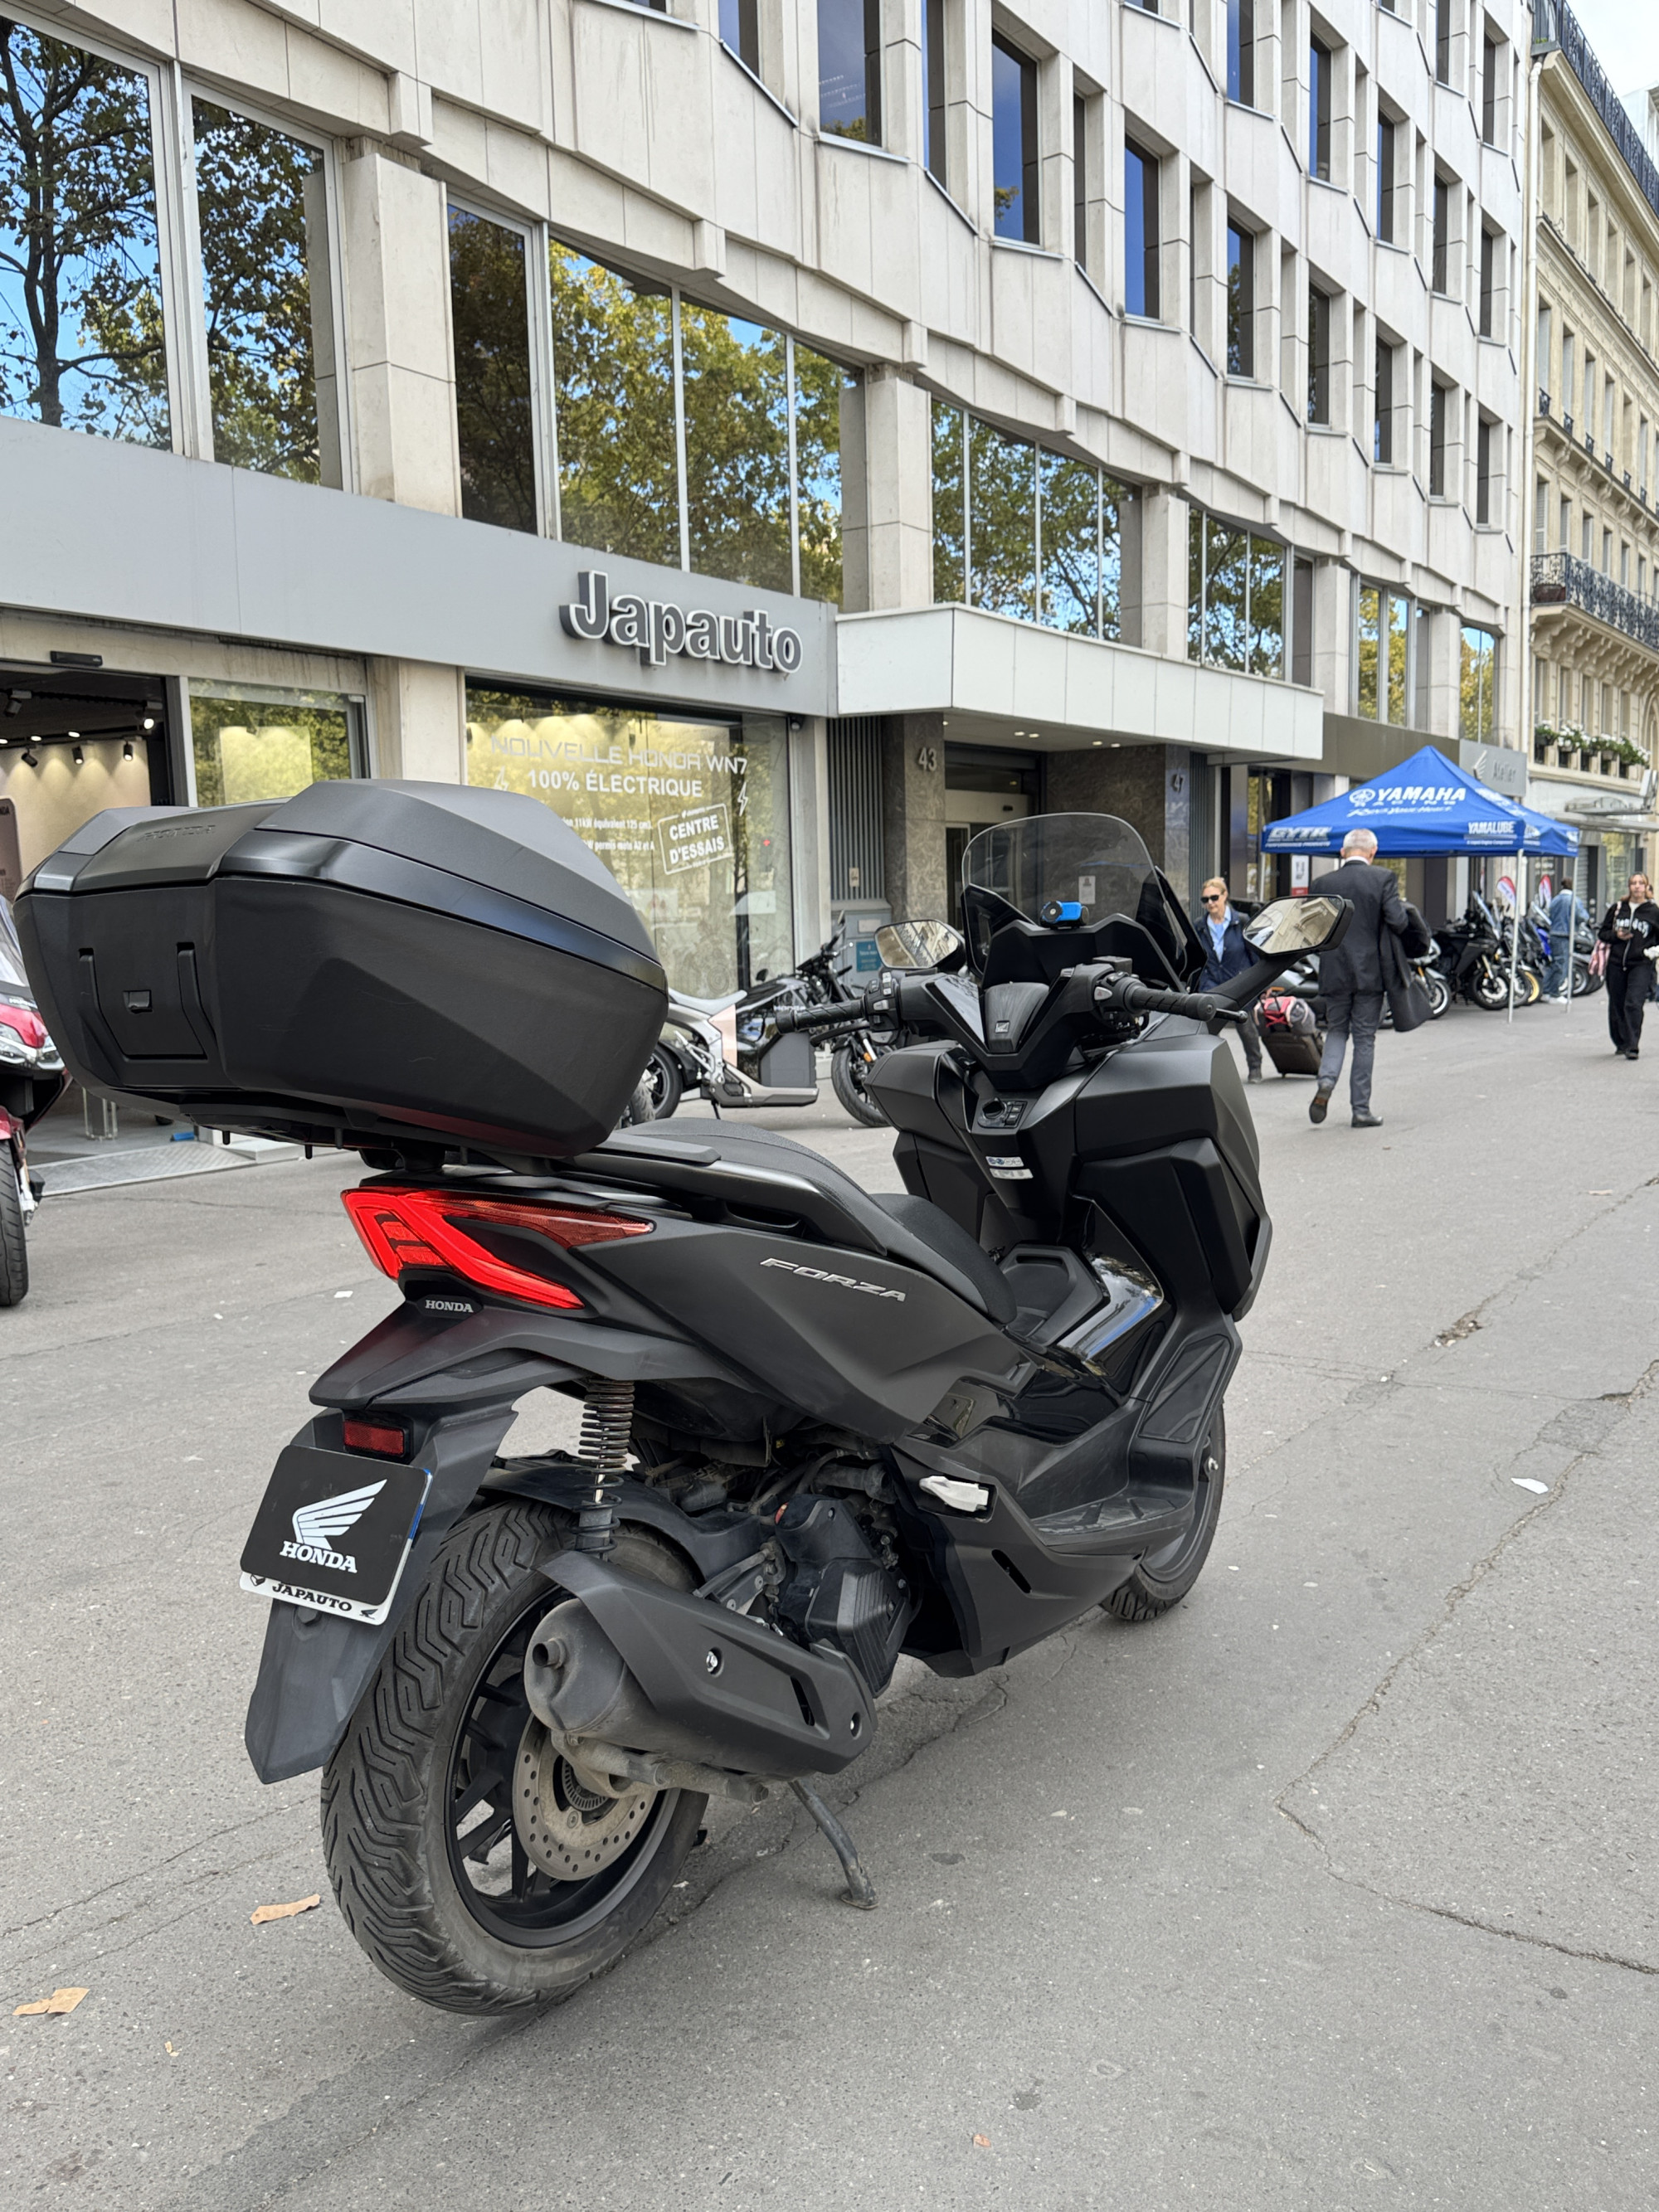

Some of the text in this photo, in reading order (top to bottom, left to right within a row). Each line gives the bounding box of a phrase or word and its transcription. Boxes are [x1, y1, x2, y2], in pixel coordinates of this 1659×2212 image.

[559, 569, 803, 673] Japauto
[491, 735, 624, 765] NOUVELLE
[705, 754, 747, 775] WN7
[917, 747, 937, 771] 43
[528, 769, 703, 797] 100% ÉLECTRIQUE
[1493, 760, 1516, 783] Atelier
[1377, 786, 1467, 802] YAMAHA
[669, 814, 719, 841] CENTRE
[1467, 820, 1516, 834] YAMALUBE
[669, 835, 725, 864] D'ESSAIS
[760, 1258, 906, 1302] FORZA
[425, 1300, 474, 1313] HONDA
[280, 1540, 358, 1573] HONDA
[272, 1582, 353, 1612] JAPAUTO
